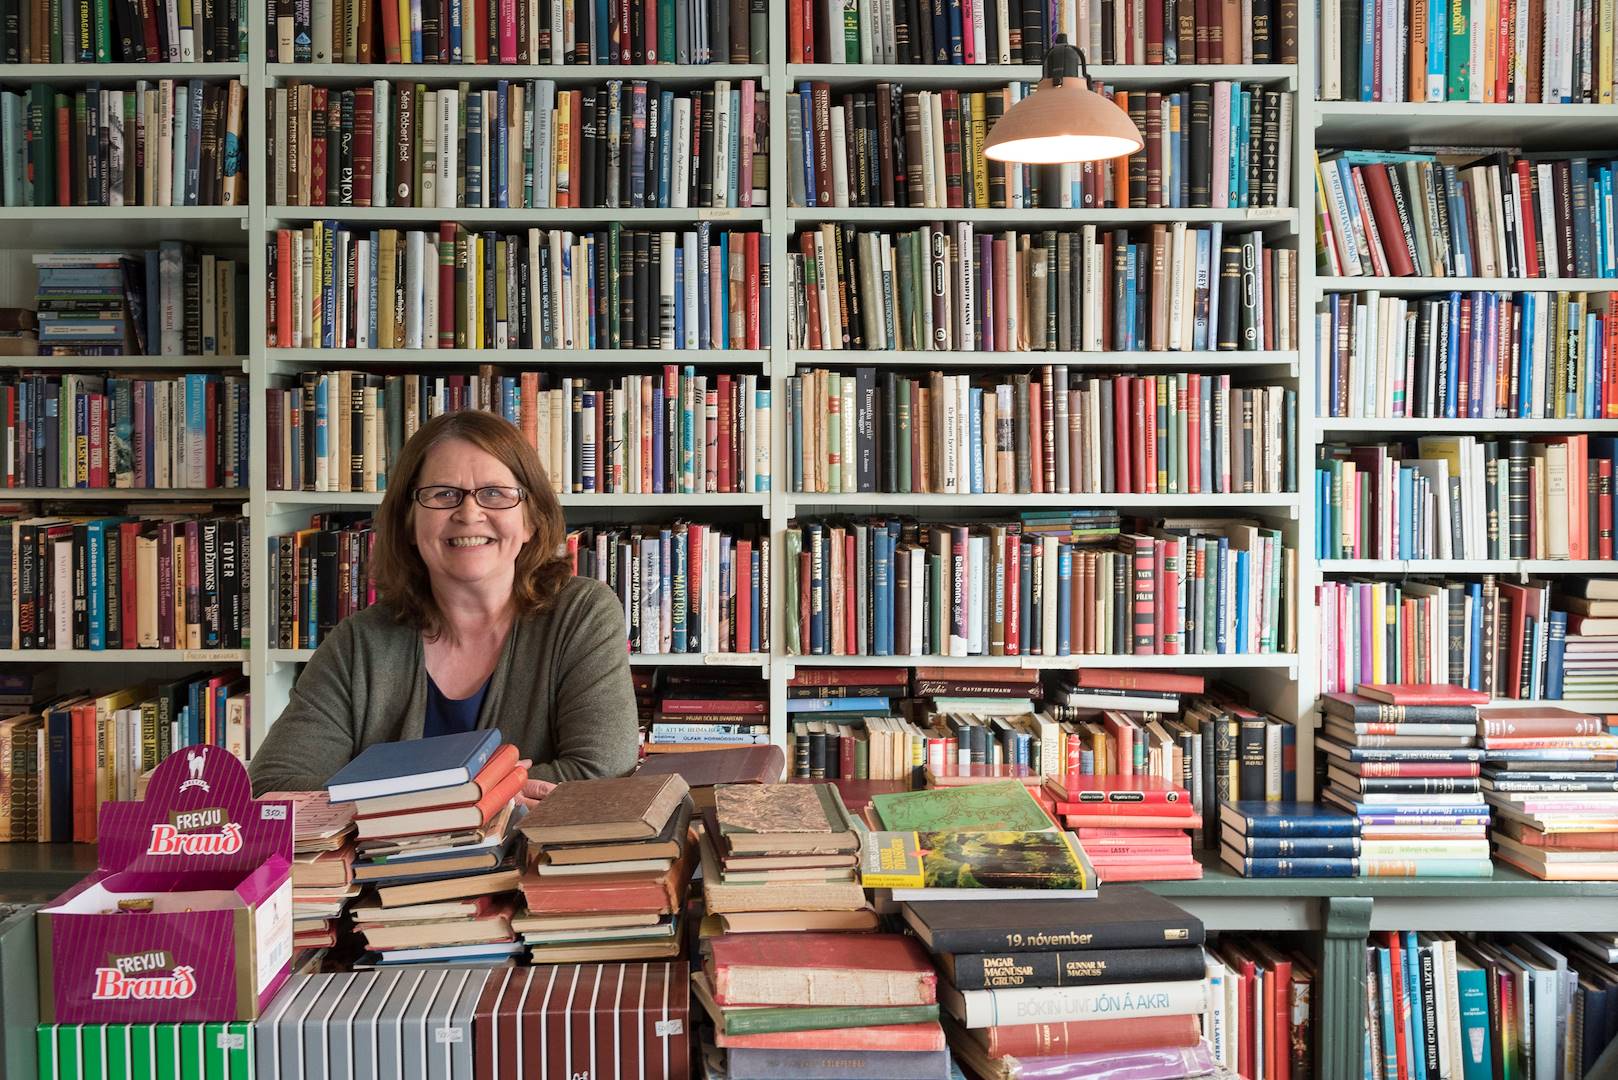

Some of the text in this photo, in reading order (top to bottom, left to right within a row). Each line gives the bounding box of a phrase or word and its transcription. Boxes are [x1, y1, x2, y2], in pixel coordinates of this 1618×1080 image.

[400, 90, 410, 162] Séra Róbert Jack
[650, 99, 658, 138] SVERRIR
[340, 168, 352, 204] Kolka
[23, 550, 32, 594] McDermid
[204, 526, 216, 590] DAVID EDDINGS
[223, 540, 234, 578] TOYER
[955, 556, 963, 604] Belladonna
[160, 697, 169, 724] Bengt
[176, 808, 221, 830] FREYJU
[146, 822, 244, 856] Brauð
[1006, 932, 1093, 946] 19. nóvember
[116, 952, 166, 974] FREYJU
[984, 958, 1014, 967] DAGAR
[1424, 957, 1432, 988] HELZTU
[92, 966, 196, 1000] Brauð
[992, 976, 1024, 985] GRUND
[1092, 993, 1120, 1012] JÓN
[1123, 992, 1134, 1010] Á
[1136, 993, 1170, 1010] AKRI
